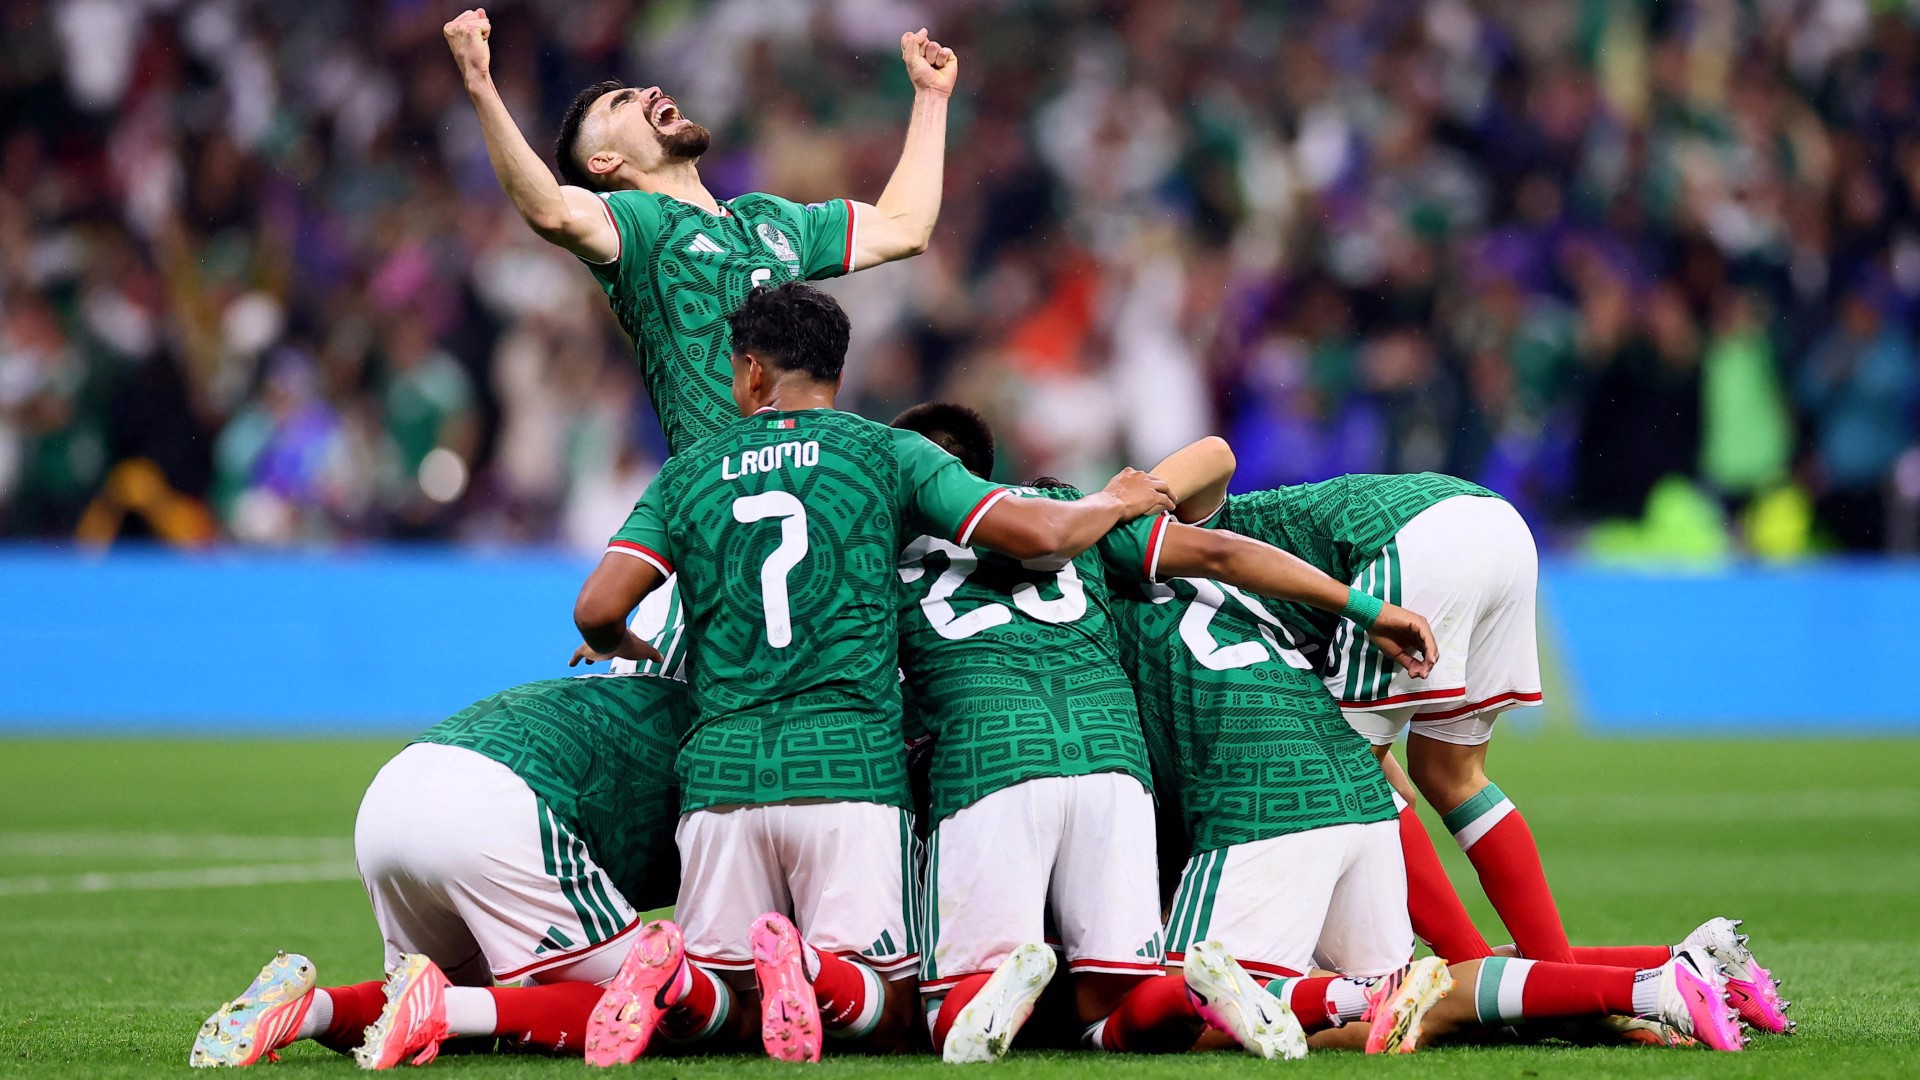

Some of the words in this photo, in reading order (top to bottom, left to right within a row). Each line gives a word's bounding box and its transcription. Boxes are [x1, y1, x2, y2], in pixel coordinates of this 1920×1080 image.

[721, 440, 819, 481] L.ROMO
[732, 490, 809, 649] 7
[897, 534, 1088, 640] 23
